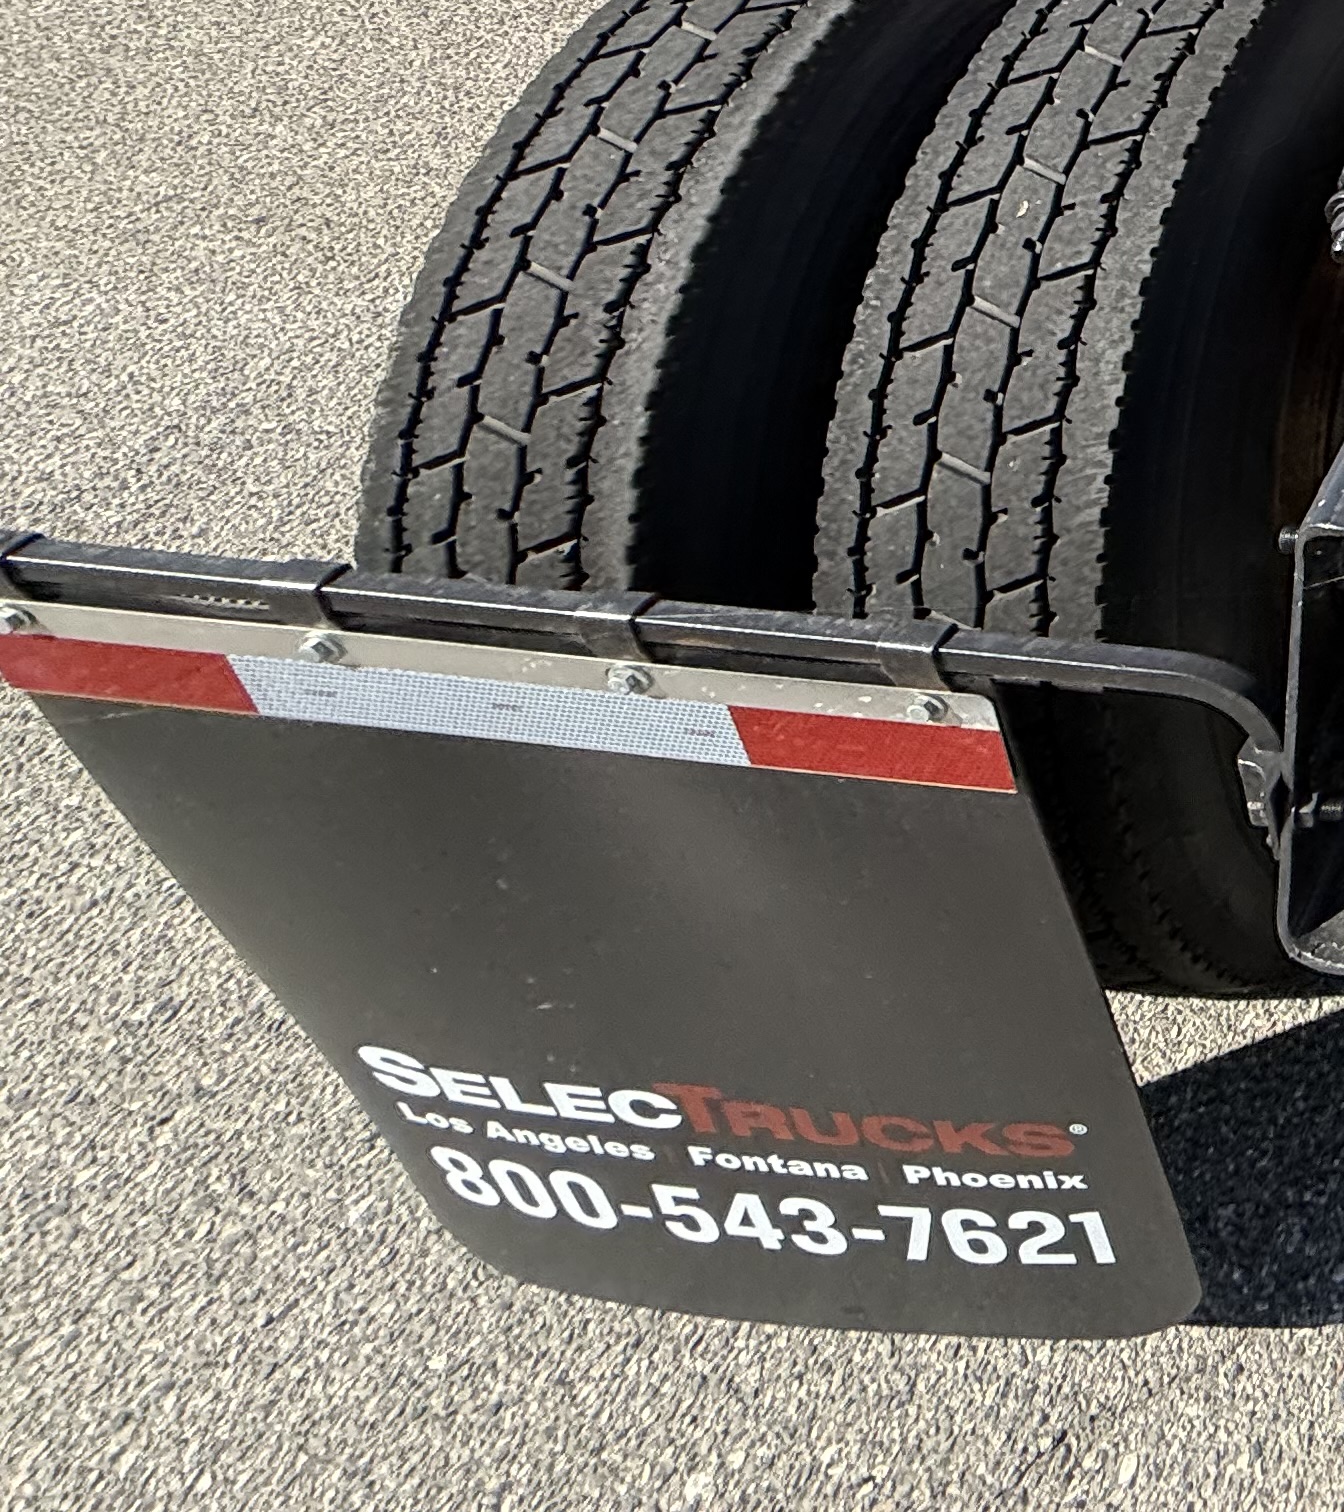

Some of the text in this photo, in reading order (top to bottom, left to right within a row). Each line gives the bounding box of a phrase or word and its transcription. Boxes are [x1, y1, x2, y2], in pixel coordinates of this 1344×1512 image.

[396, 1101, 1088, 1190] Los Angeles Fontana Phoenix
[430, 1145, 1116, 1265] 800-543-7621
